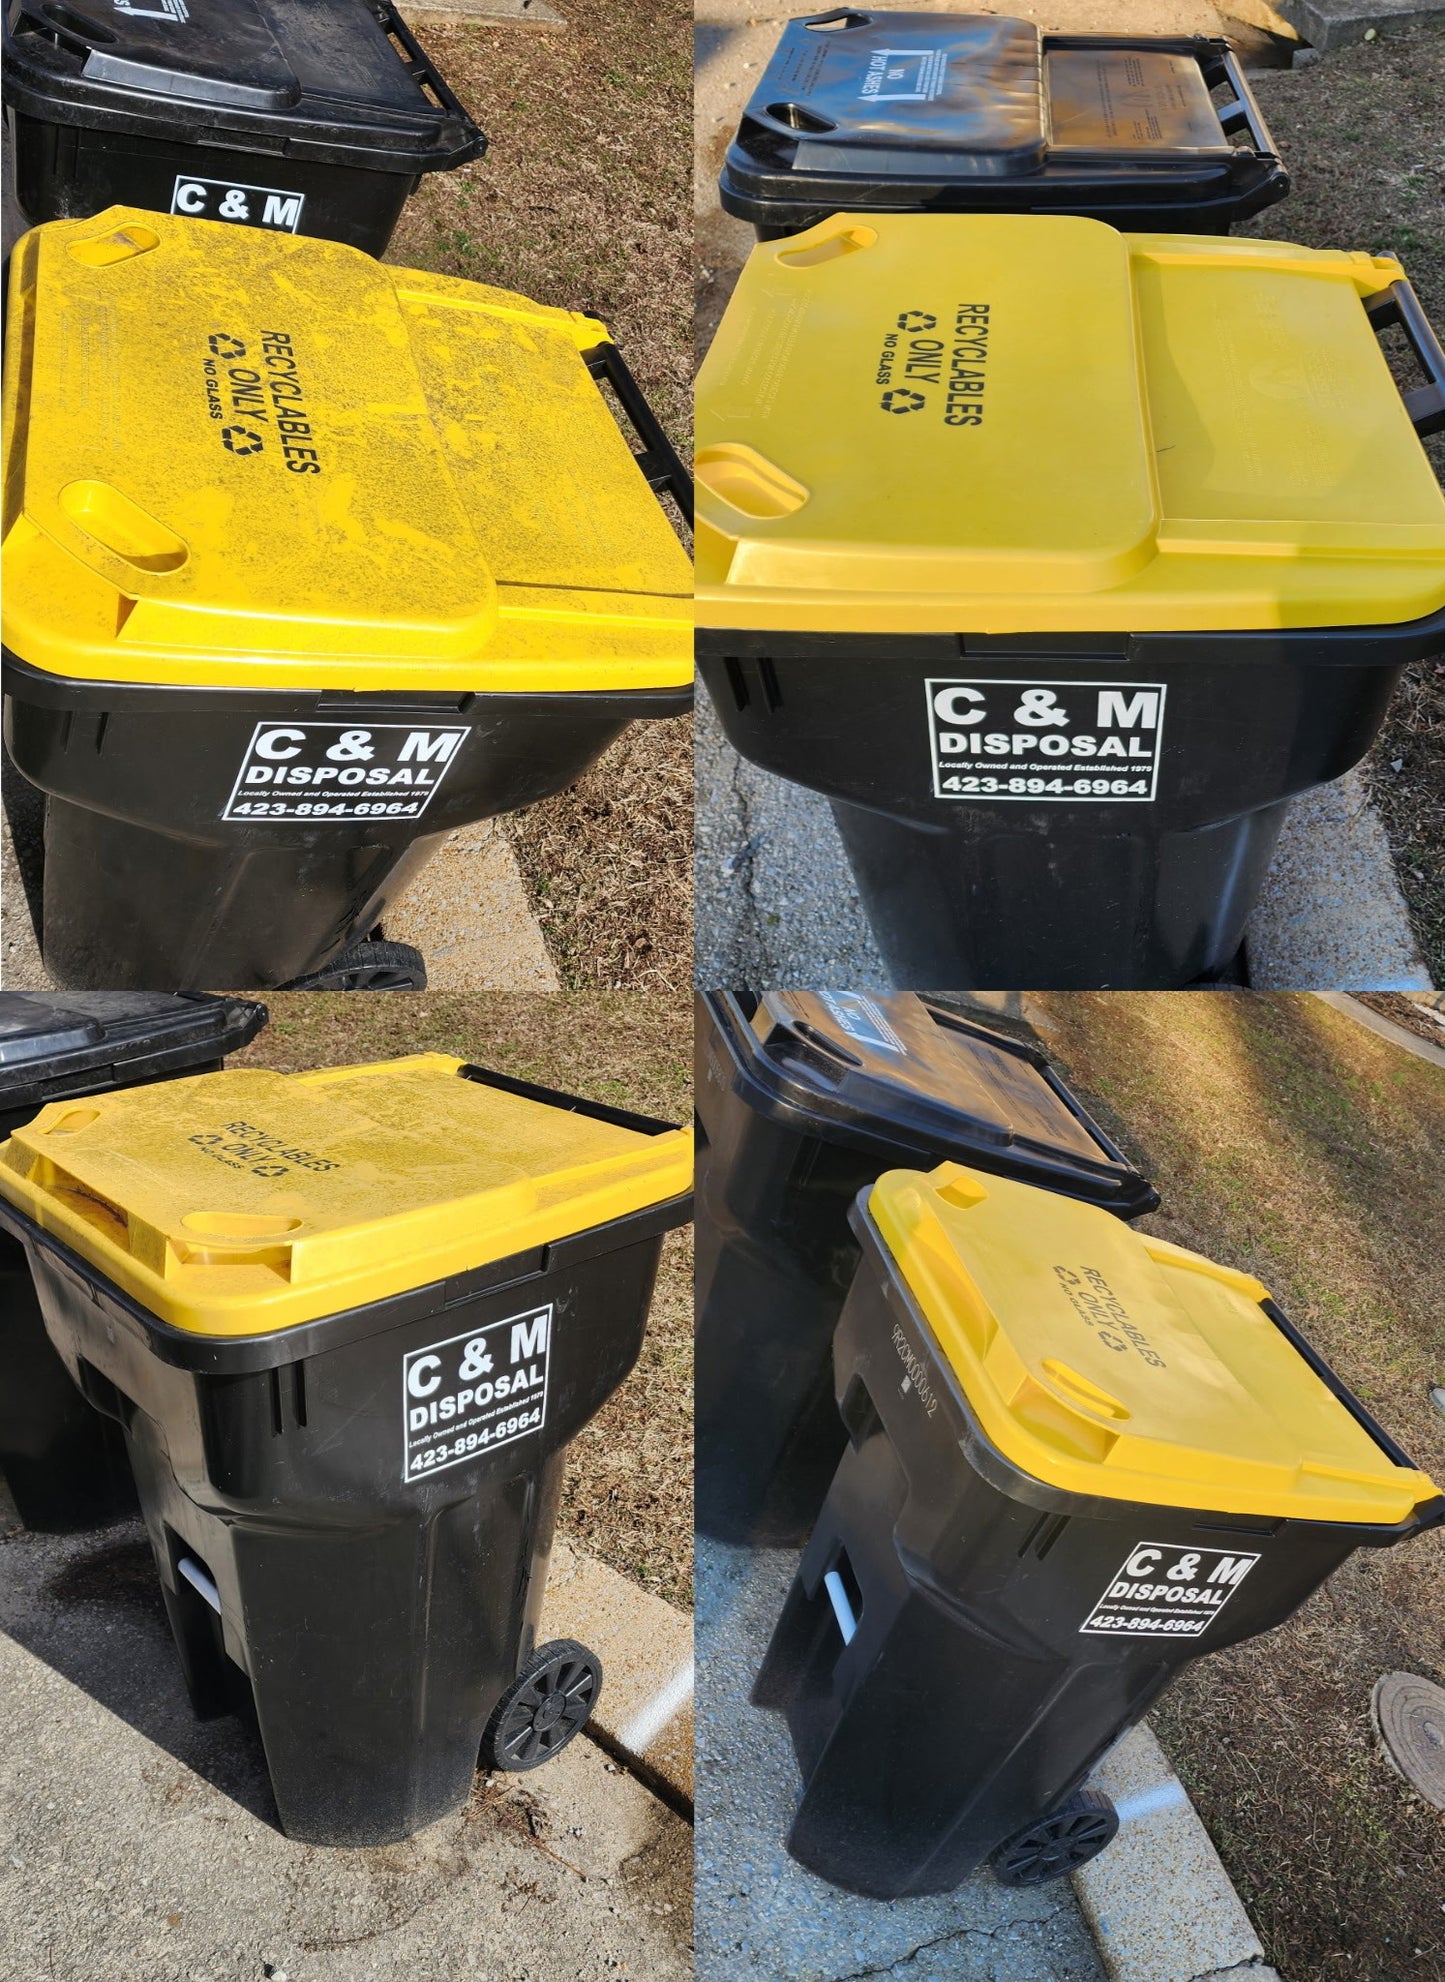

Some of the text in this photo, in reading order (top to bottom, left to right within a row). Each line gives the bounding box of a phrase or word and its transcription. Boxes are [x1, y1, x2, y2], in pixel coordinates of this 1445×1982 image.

[176, 183, 299, 226] C & M
[876, 333, 898, 385] NO GLASS
[904, 339, 944, 384] ONLY
[944, 304, 990, 426] RECYCLABLES
[203, 358, 223, 420] NO GLASS
[228, 368, 269, 422] ONLY
[260, 330, 321, 474] RECYCLABLES
[934, 687, 1159, 729] C & M
[255, 729, 461, 763] C & M
[939, 732, 1152, 758] DISPOSAL
[245, 766, 435, 785] DISPOSAL
[939, 761, 974, 770] Locally
[1029, 763, 1073, 771] Operated
[1073, 764, 1129, 772] Established
[942, 776, 1148, 795] 423-894-6964
[232, 801, 418, 816] 423-894-6964
[221, 1121, 340, 1172] RECYCLABLES
[221, 1143, 276, 1163] ONLY
[1059, 1282, 1072, 1296] NO
[1078, 1291, 1119, 1331] ONLY
[1080, 1265, 1167, 1368] RECYCLABLES
[407, 1314, 548, 1398] C & M
[410, 1364, 544, 1432] DISPOSAL
[409, 1434, 432, 1448] Locally
[433, 1426, 455, 1439] Owned
[455, 1420, 467, 1432] and
[410, 1407, 540, 1470] 423-894-6964
[1126, 1548, 1253, 1585] C & M
[1108, 1582, 1223, 1605] DISPOSAL
[1089, 1615, 1205, 1632] 423-894-6964
